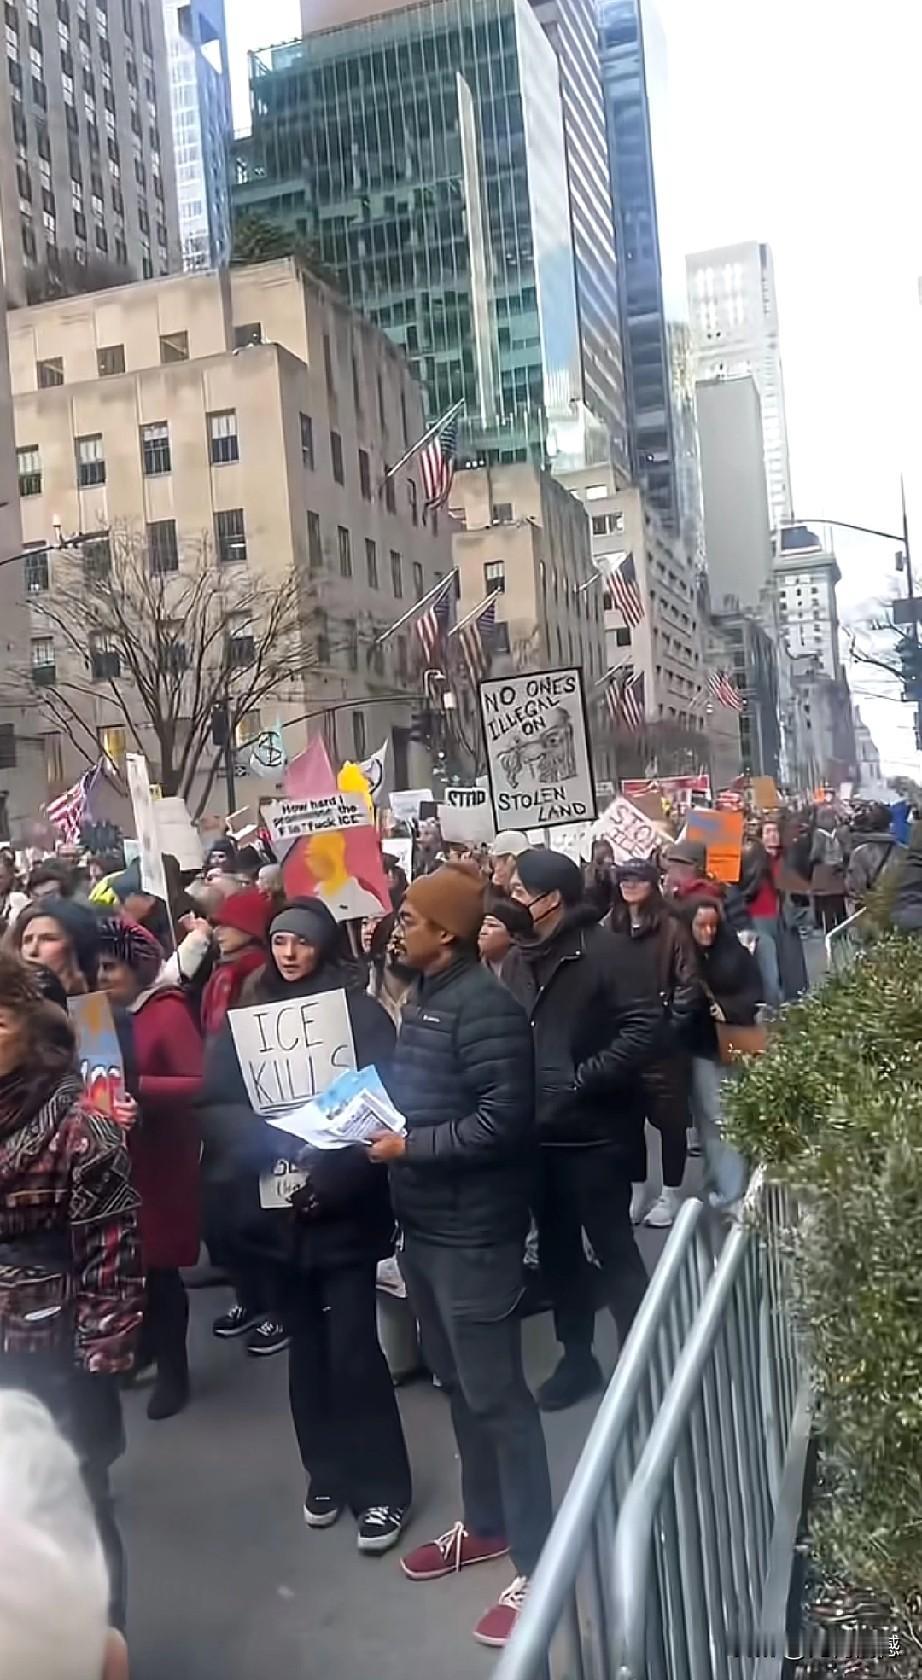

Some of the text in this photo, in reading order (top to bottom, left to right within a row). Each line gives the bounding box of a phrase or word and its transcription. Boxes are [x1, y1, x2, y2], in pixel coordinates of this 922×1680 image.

[484, 676, 576, 713] NO ONES
[487, 695, 560, 741] ILLEGAL
[521, 715, 547, 736] ON
[282, 803, 307, 815] How
[310, 796, 337, 809] hard
[498, 786, 566, 812] STOLEN
[538, 802, 587, 822] LAND
[253, 1002, 324, 1054] ICE
